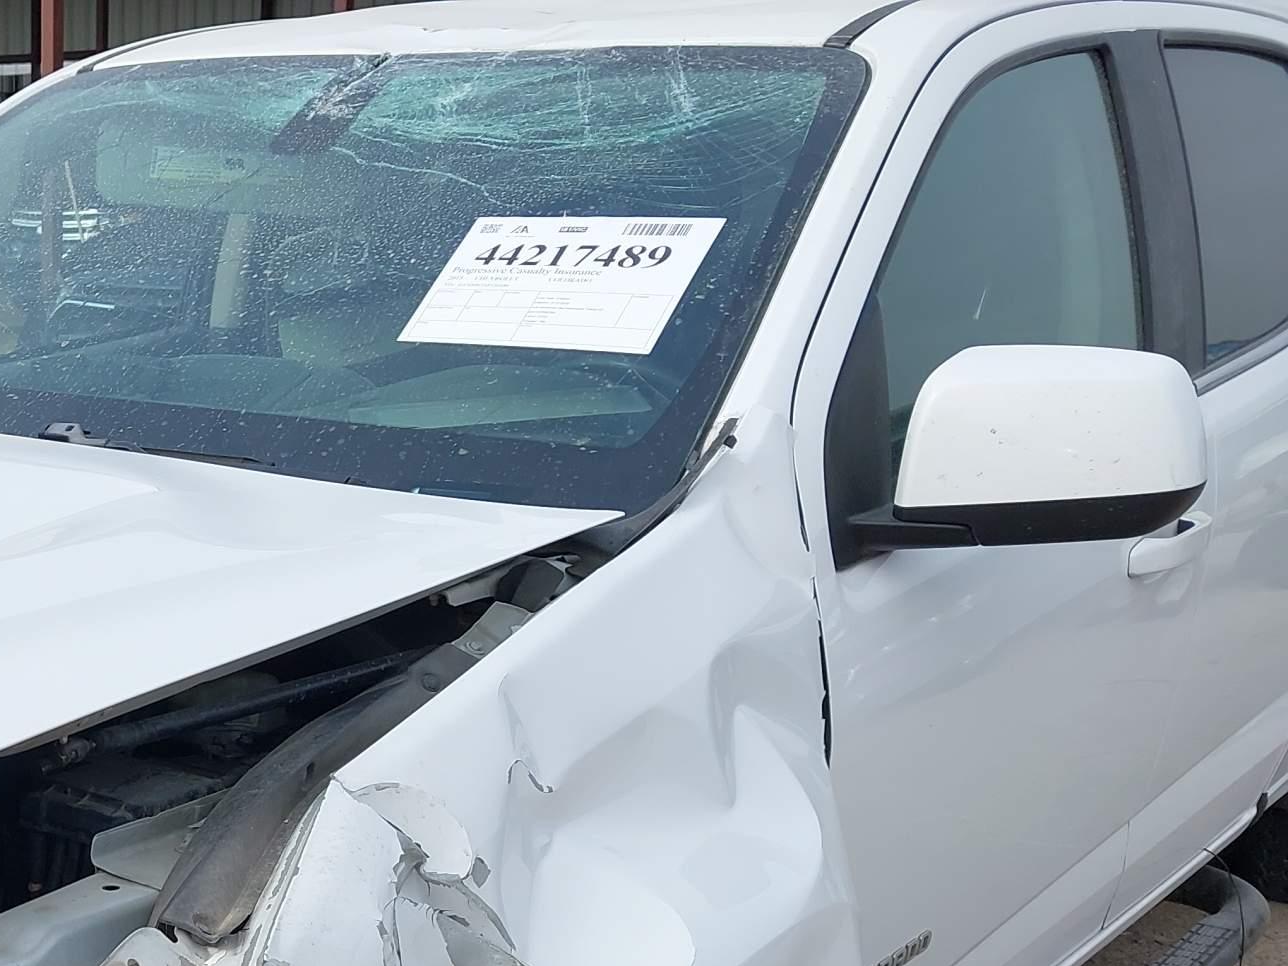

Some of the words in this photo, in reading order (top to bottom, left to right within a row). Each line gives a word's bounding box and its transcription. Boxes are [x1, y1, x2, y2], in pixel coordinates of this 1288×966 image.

[474, 244, 672, 268] 44217489
[452, 266, 507, 275] Progressive
[510, 266, 552, 276] Casualty
[554, 267, 602, 276] Insurance
